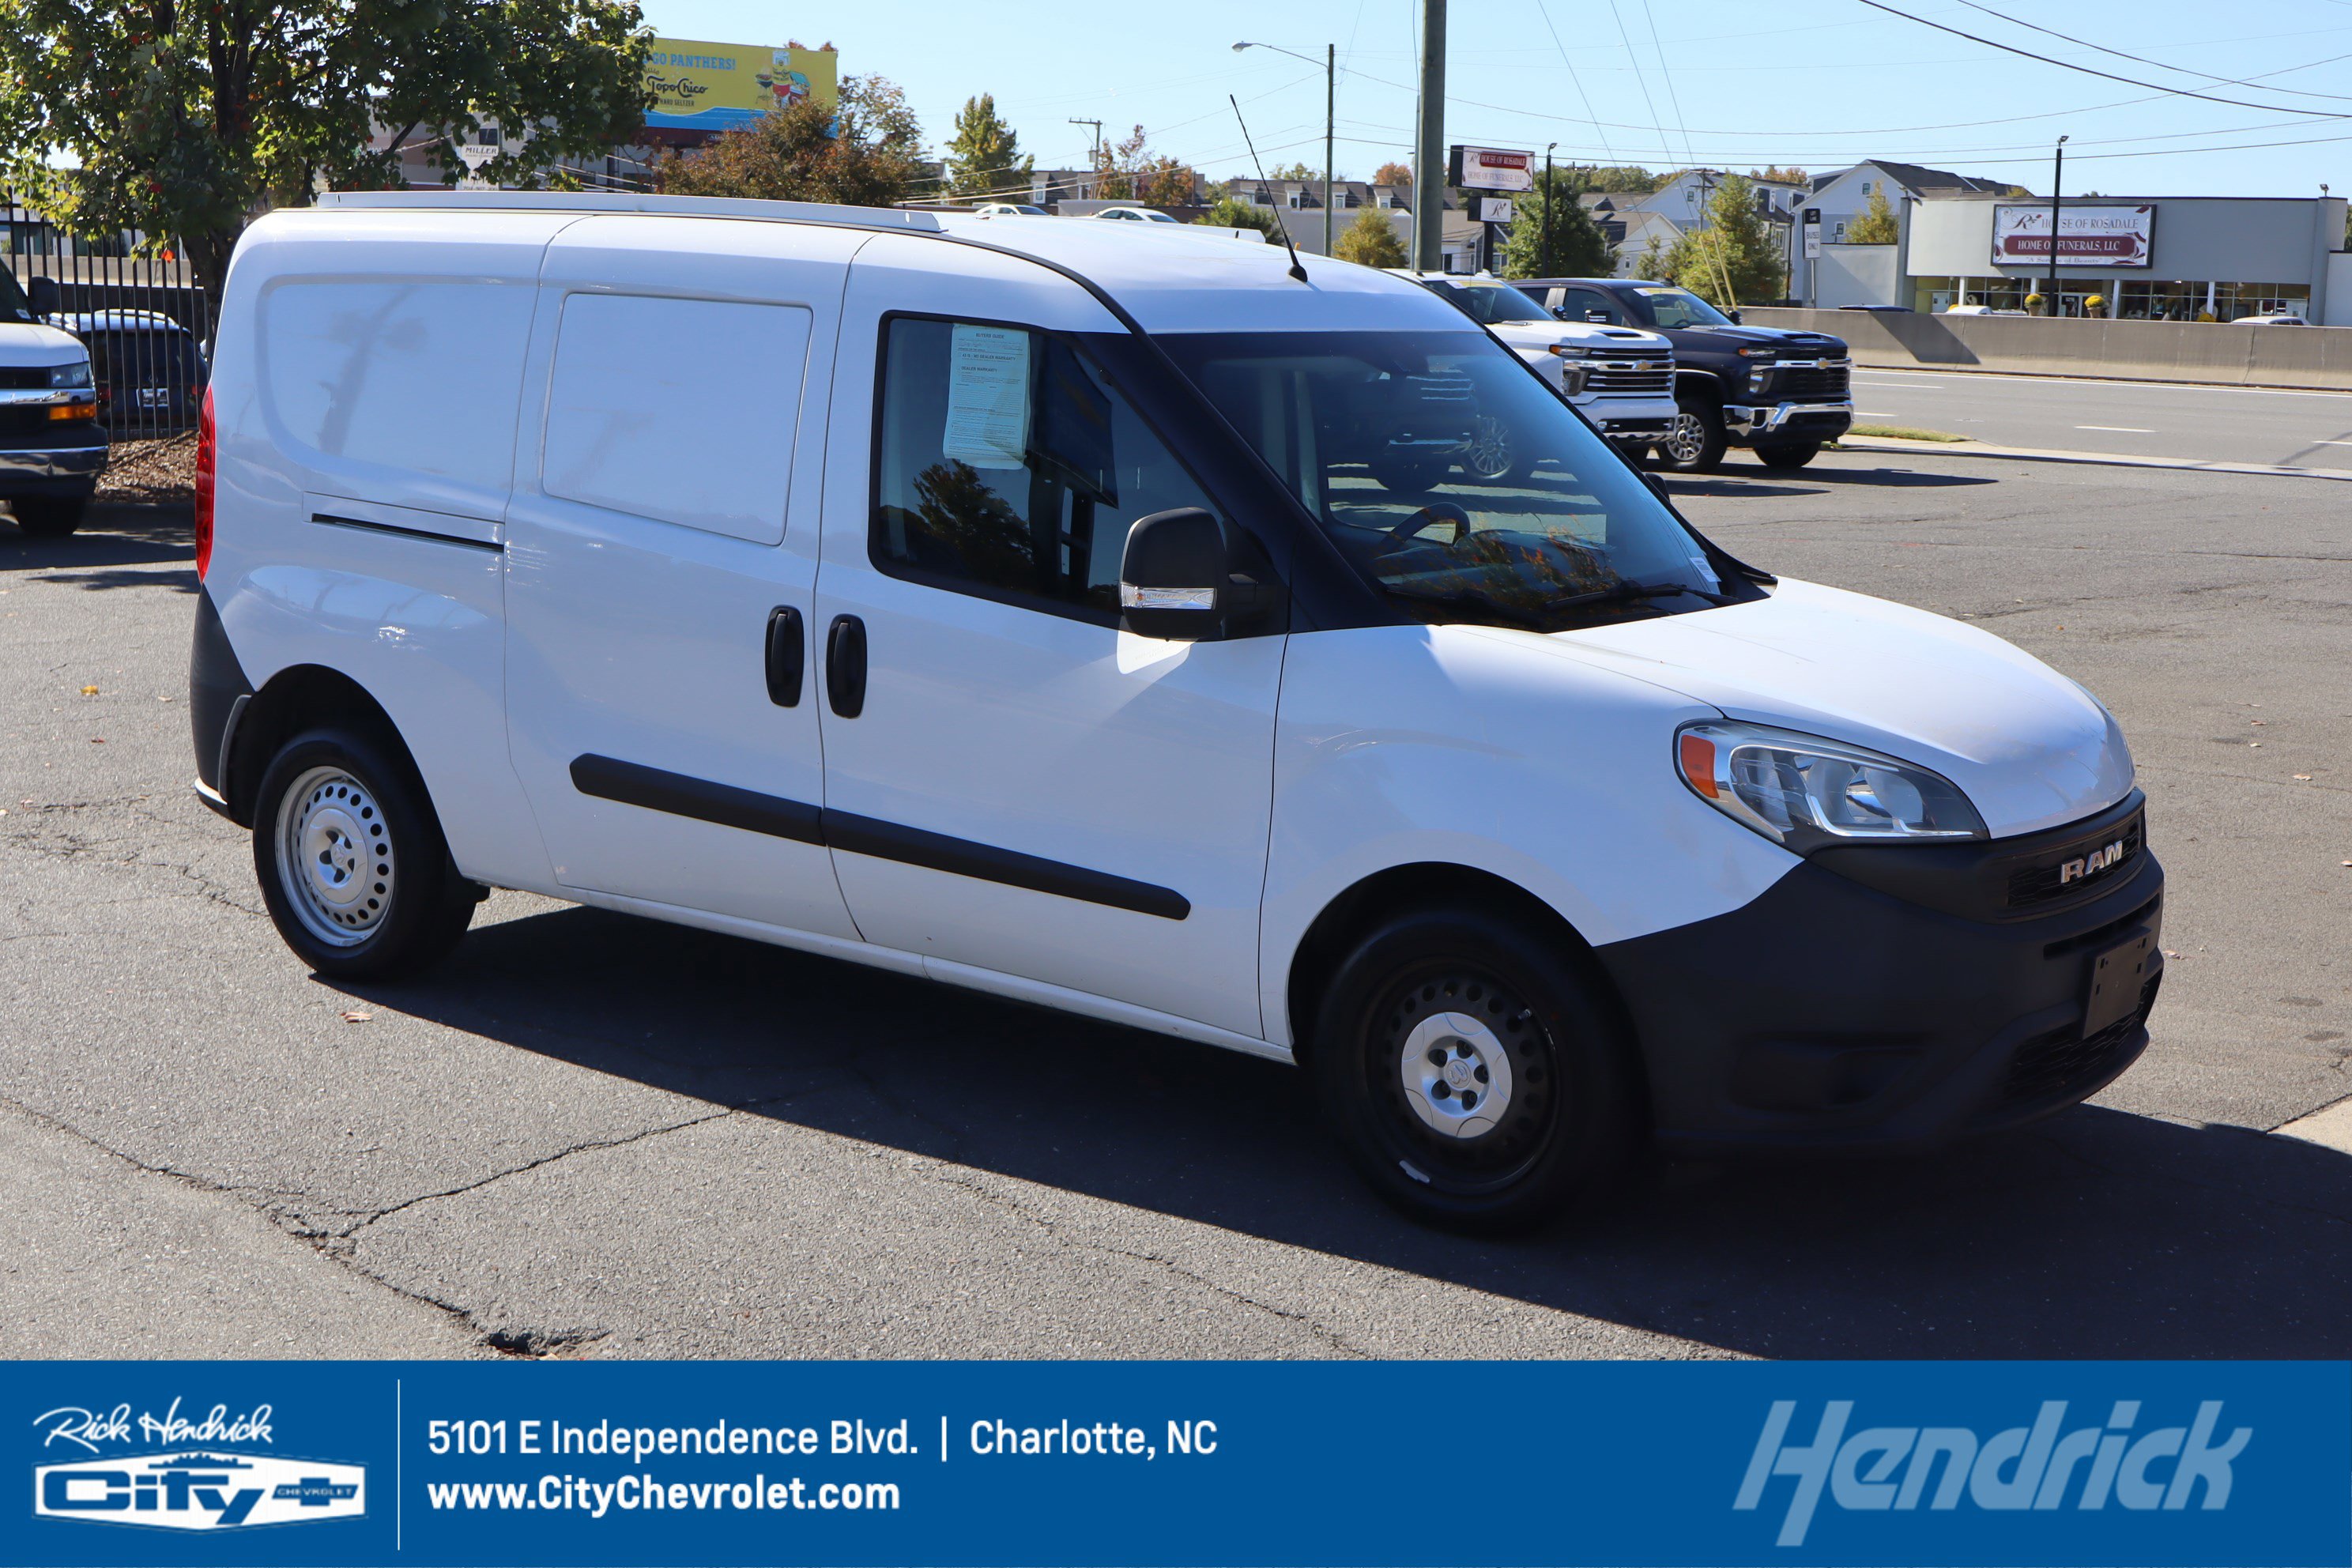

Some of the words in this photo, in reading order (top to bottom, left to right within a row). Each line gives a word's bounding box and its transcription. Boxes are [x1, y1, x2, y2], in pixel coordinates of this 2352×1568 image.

[653, 53, 667, 65] GO
[670, 54, 737, 71] PANTHERS!
[646, 75, 678, 93] Topo
[678, 77, 708, 98] Chico
[1481, 153, 1495, 163] HOUSE
[1503, 156, 1526, 166] ROSADALE
[2042, 218, 2074, 228] HOSE
[2075, 219, 2087, 228] OF
[2090, 219, 2138, 229] ROSADALE
[2018, 240, 2042, 250] HOME
[2044, 240, 2052, 251] O
[2057, 240, 2102, 252] FUNERALS,
[2104, 241, 2120, 251] LLC
[2061, 840, 2123, 884] RAM
